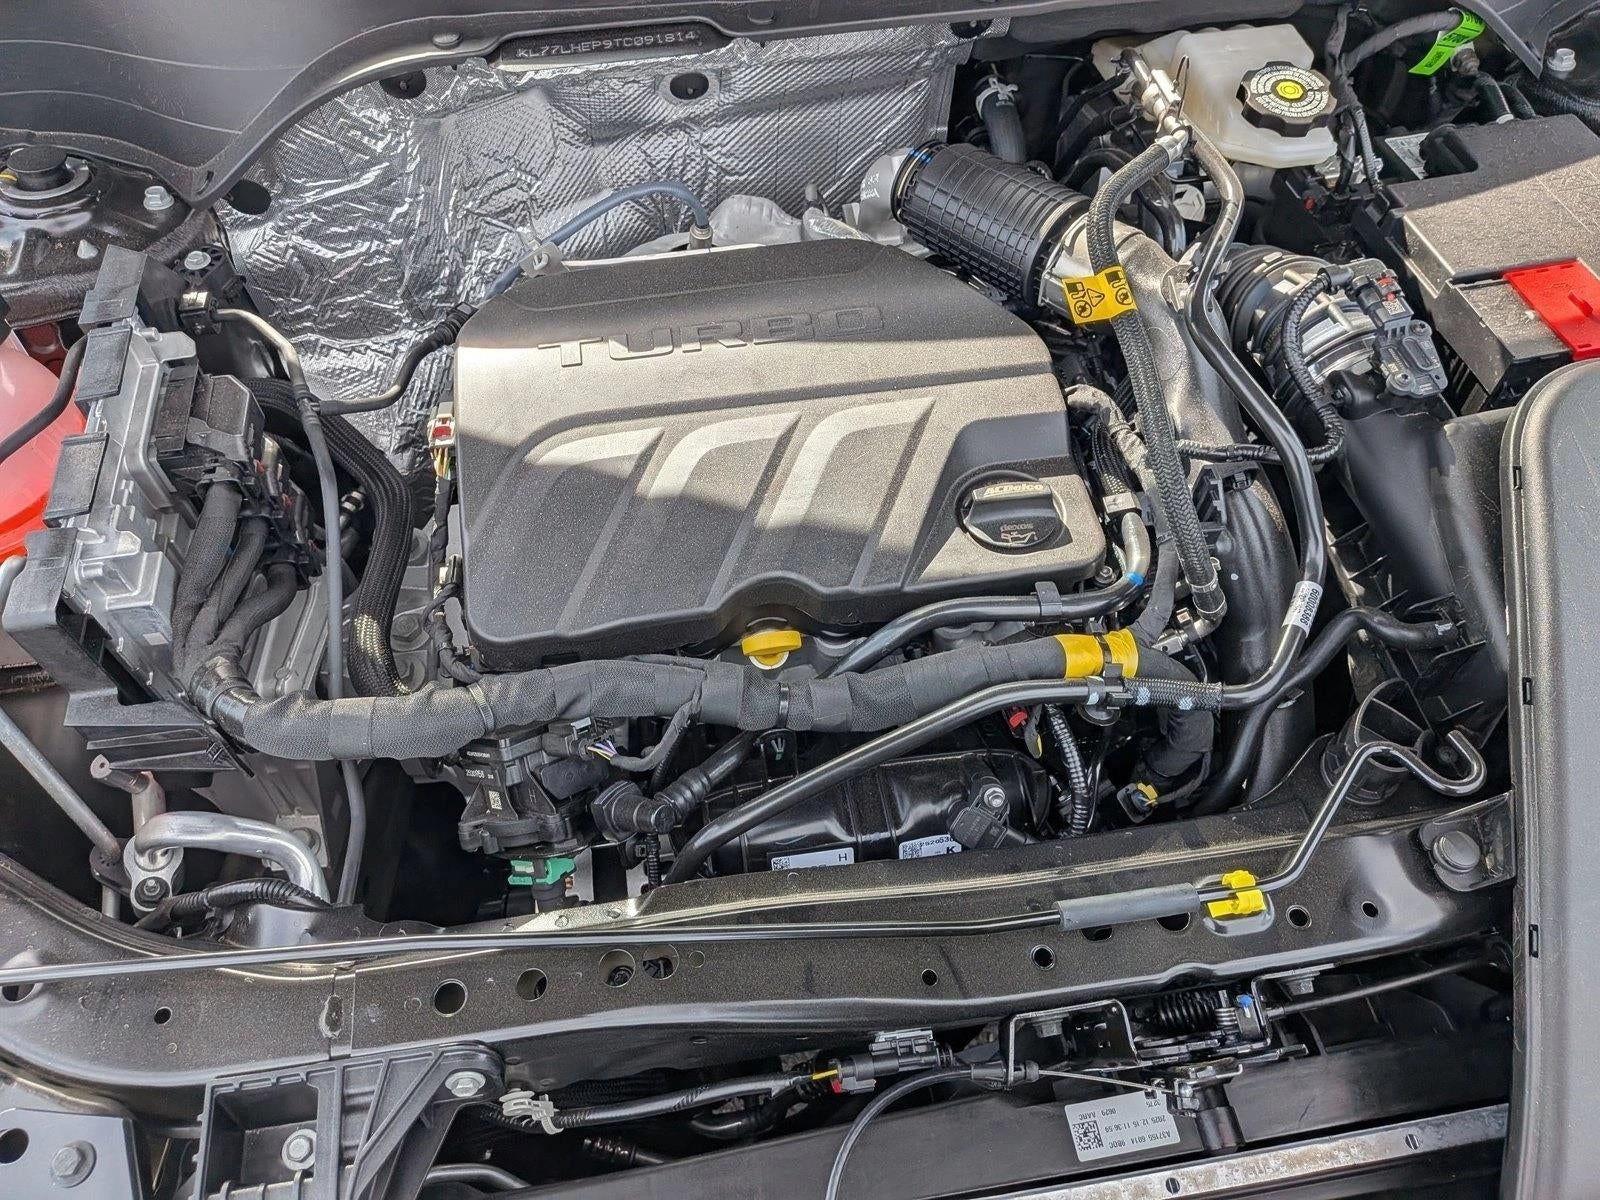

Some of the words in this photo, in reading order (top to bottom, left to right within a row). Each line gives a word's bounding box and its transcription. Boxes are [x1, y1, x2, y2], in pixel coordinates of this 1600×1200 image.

[537, 304, 884, 368] TURBO
[983, 483, 1044, 497] ACDelco
[999, 522, 1034, 532] dexos
[838, 852, 848, 862] H
